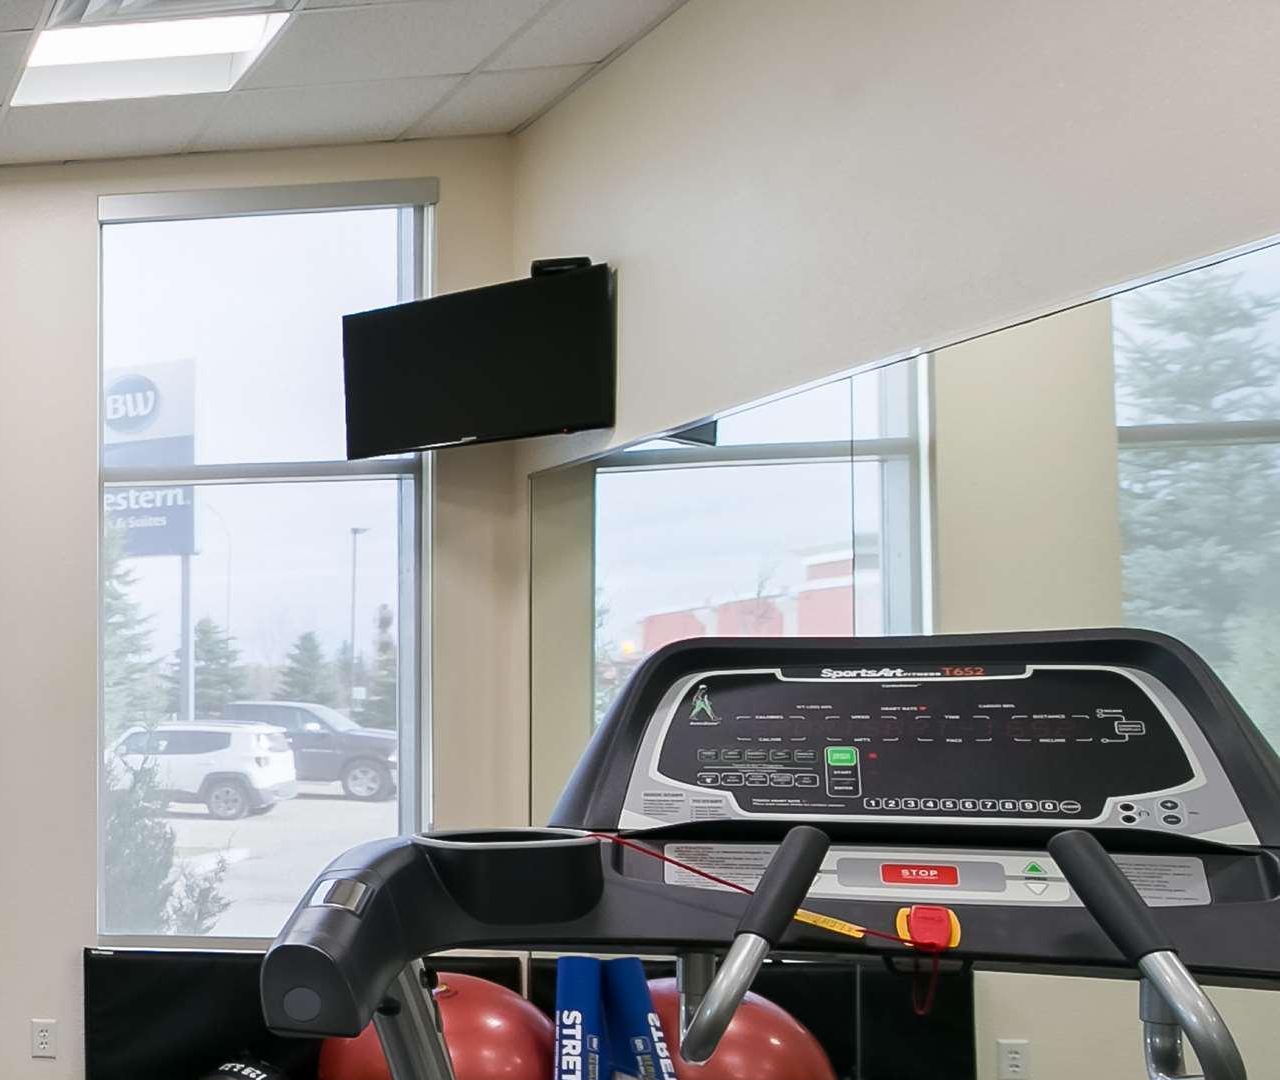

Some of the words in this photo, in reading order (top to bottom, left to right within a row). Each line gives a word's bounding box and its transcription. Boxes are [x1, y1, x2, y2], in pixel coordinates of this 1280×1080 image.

[105, 390, 155, 420] BW
[820, 668, 904, 679] SportsArt
[941, 667, 986, 676] T652
[901, 869, 938, 877] STOP
